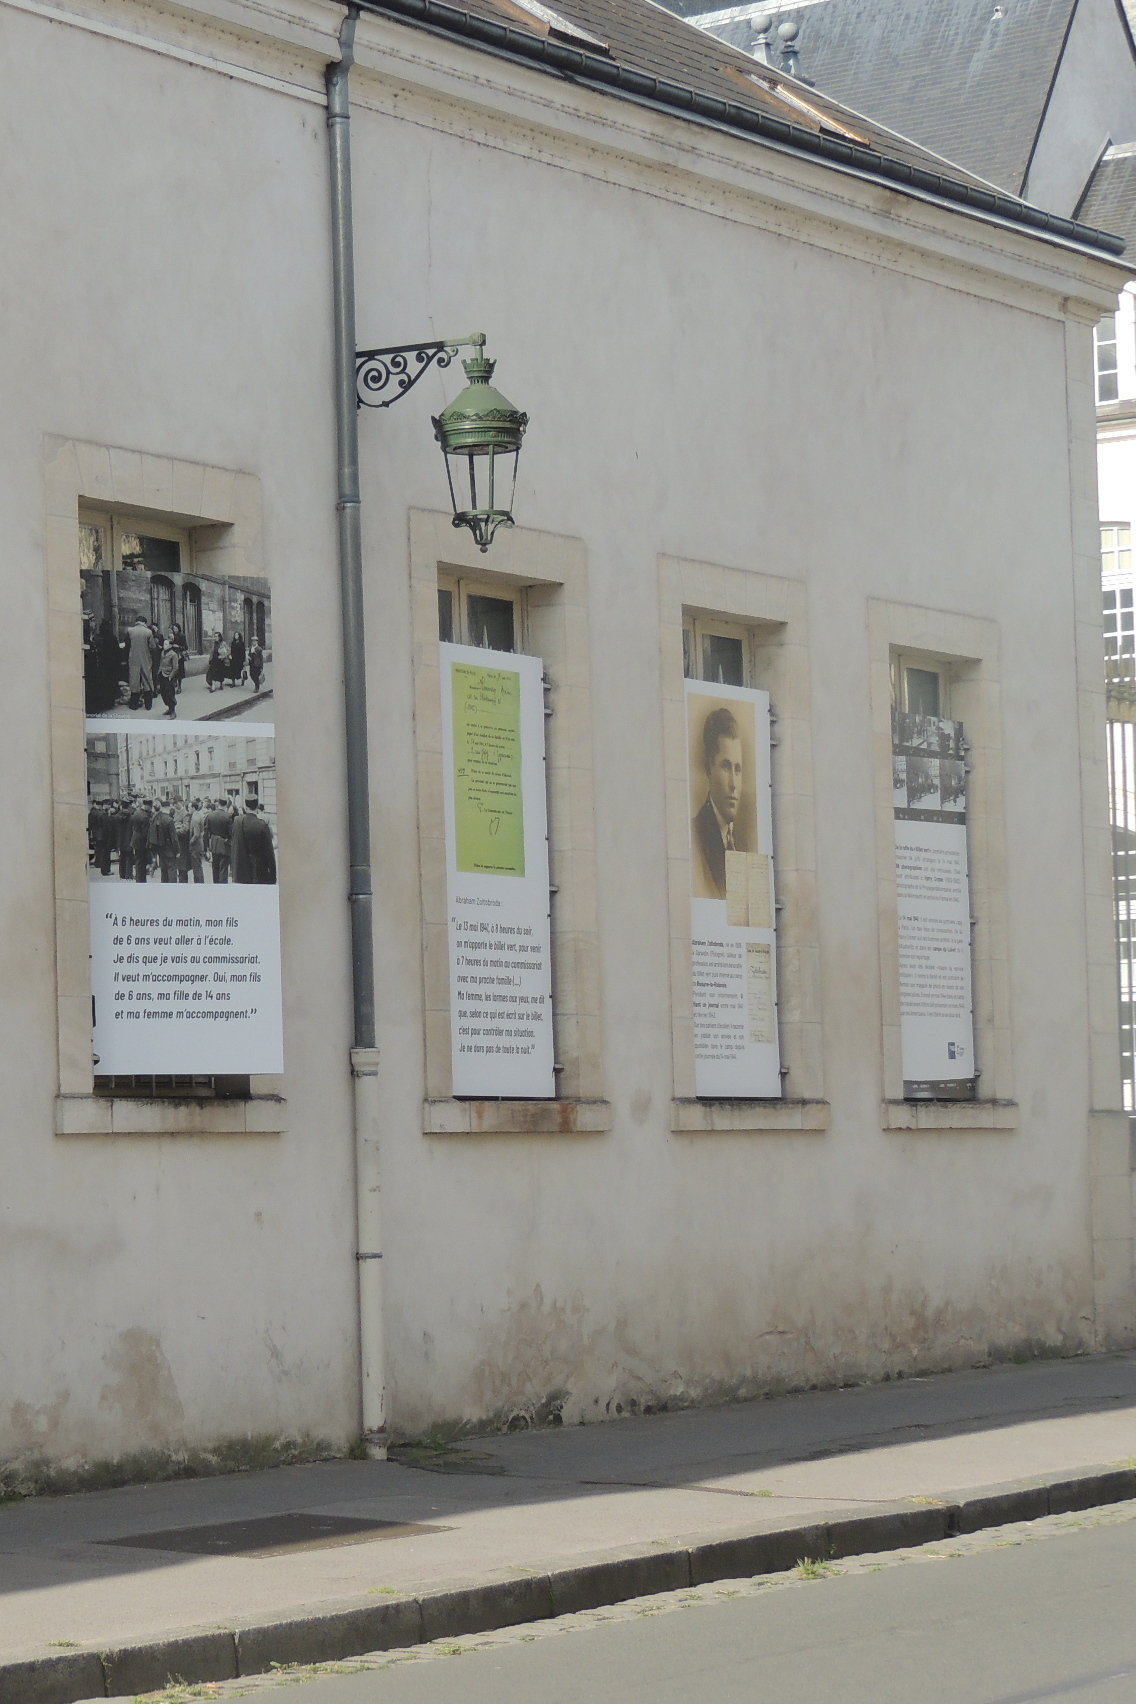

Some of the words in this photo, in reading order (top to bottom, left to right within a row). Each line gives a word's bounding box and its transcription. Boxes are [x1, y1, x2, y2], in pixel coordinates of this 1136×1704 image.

[455, 896, 476, 905] Abraham
[105, 913, 119, 927] “À
[122, 916, 127, 927] 6
[129, 916, 160, 927] heures
[162, 917, 173, 927] du
[176, 917, 202, 928] matin,
[205, 919, 223, 927] mon
[226, 917, 238, 928] fils
[463, 921, 469, 932] 13
[469, 922, 479, 932] mai
[491, 923, 495, 934] à
[495, 923, 499, 934] 8
[499, 924, 516, 935] heures
[516, 925, 523, 936] du
[113, 935, 124, 946] de
[127, 935, 132, 946] 6
[135, 937, 151, 945] ans
[154, 936, 172, 945] veut
[175, 935, 194, 946] aller
[197, 935, 202, 946] à
[204, 935, 233, 946] l’école.
[489, 941, 493, 951] le
[518, 945, 529, 954] pour
[113, 953, 125, 964] Je
[127, 953, 140, 964] dis
[142, 956, 158, 966] que
[159, 953, 168, 967] je
[171, 953, 188, 964] vais
[190, 956, 201, 964] au
[203, 953, 261, 964] commissariat.
[457, 956, 461, 966] à
[461, 956, 465, 966] 7
[465, 956, 482, 967] heures
[483, 957, 489, 967] du
[489, 958, 504, 968] matin
[504, 961, 511, 969] au
[511, 960, 543, 971] commissariat
[114, 972, 120, 982] Il
[122, 973, 140, 982] veut
[142, 972, 211, 985] m’accompagner.
[213, 972, 228, 983] Oui,
[249, 972, 261, 982] fils
[457, 975, 469, 984] avec
[470, 976, 478, 984] ma
[478, 976, 495, 986] proche
[496, 975, 512, 987] famille
[114, 990, 126, 1001] de
[128, 990, 133, 1001] 6
[136, 993, 154, 1002] ans,
[157, 993, 171, 1001] ma
[173, 990, 190, 1001] fille
[192, 990, 203, 1001] de
[205, 990, 213, 1001] 14
[216, 993, 231, 1001] ans
[115, 1010, 124, 1020] et
[127, 1011, 140, 1019] ma
[143, 1009, 174, 1019] femme
[176, 1008, 257, 1022] m’accompagnent.”
[471, 1028, 482, 1038] pour
[483, 1026, 504, 1037] contrôler
[505, 1029, 513, 1037] ma
[513, 1027, 536, 1038] situation.
[459, 1043, 466, 1053] Je
[467, 1045, 473, 1053] ne
[474, 1043, 485, 1053] dors
[485, 1046, 494, 1056] pas
[495, 1044, 501, 1054] de
[502, 1045, 515, 1054] toute
[515, 1044, 520, 1054] la
